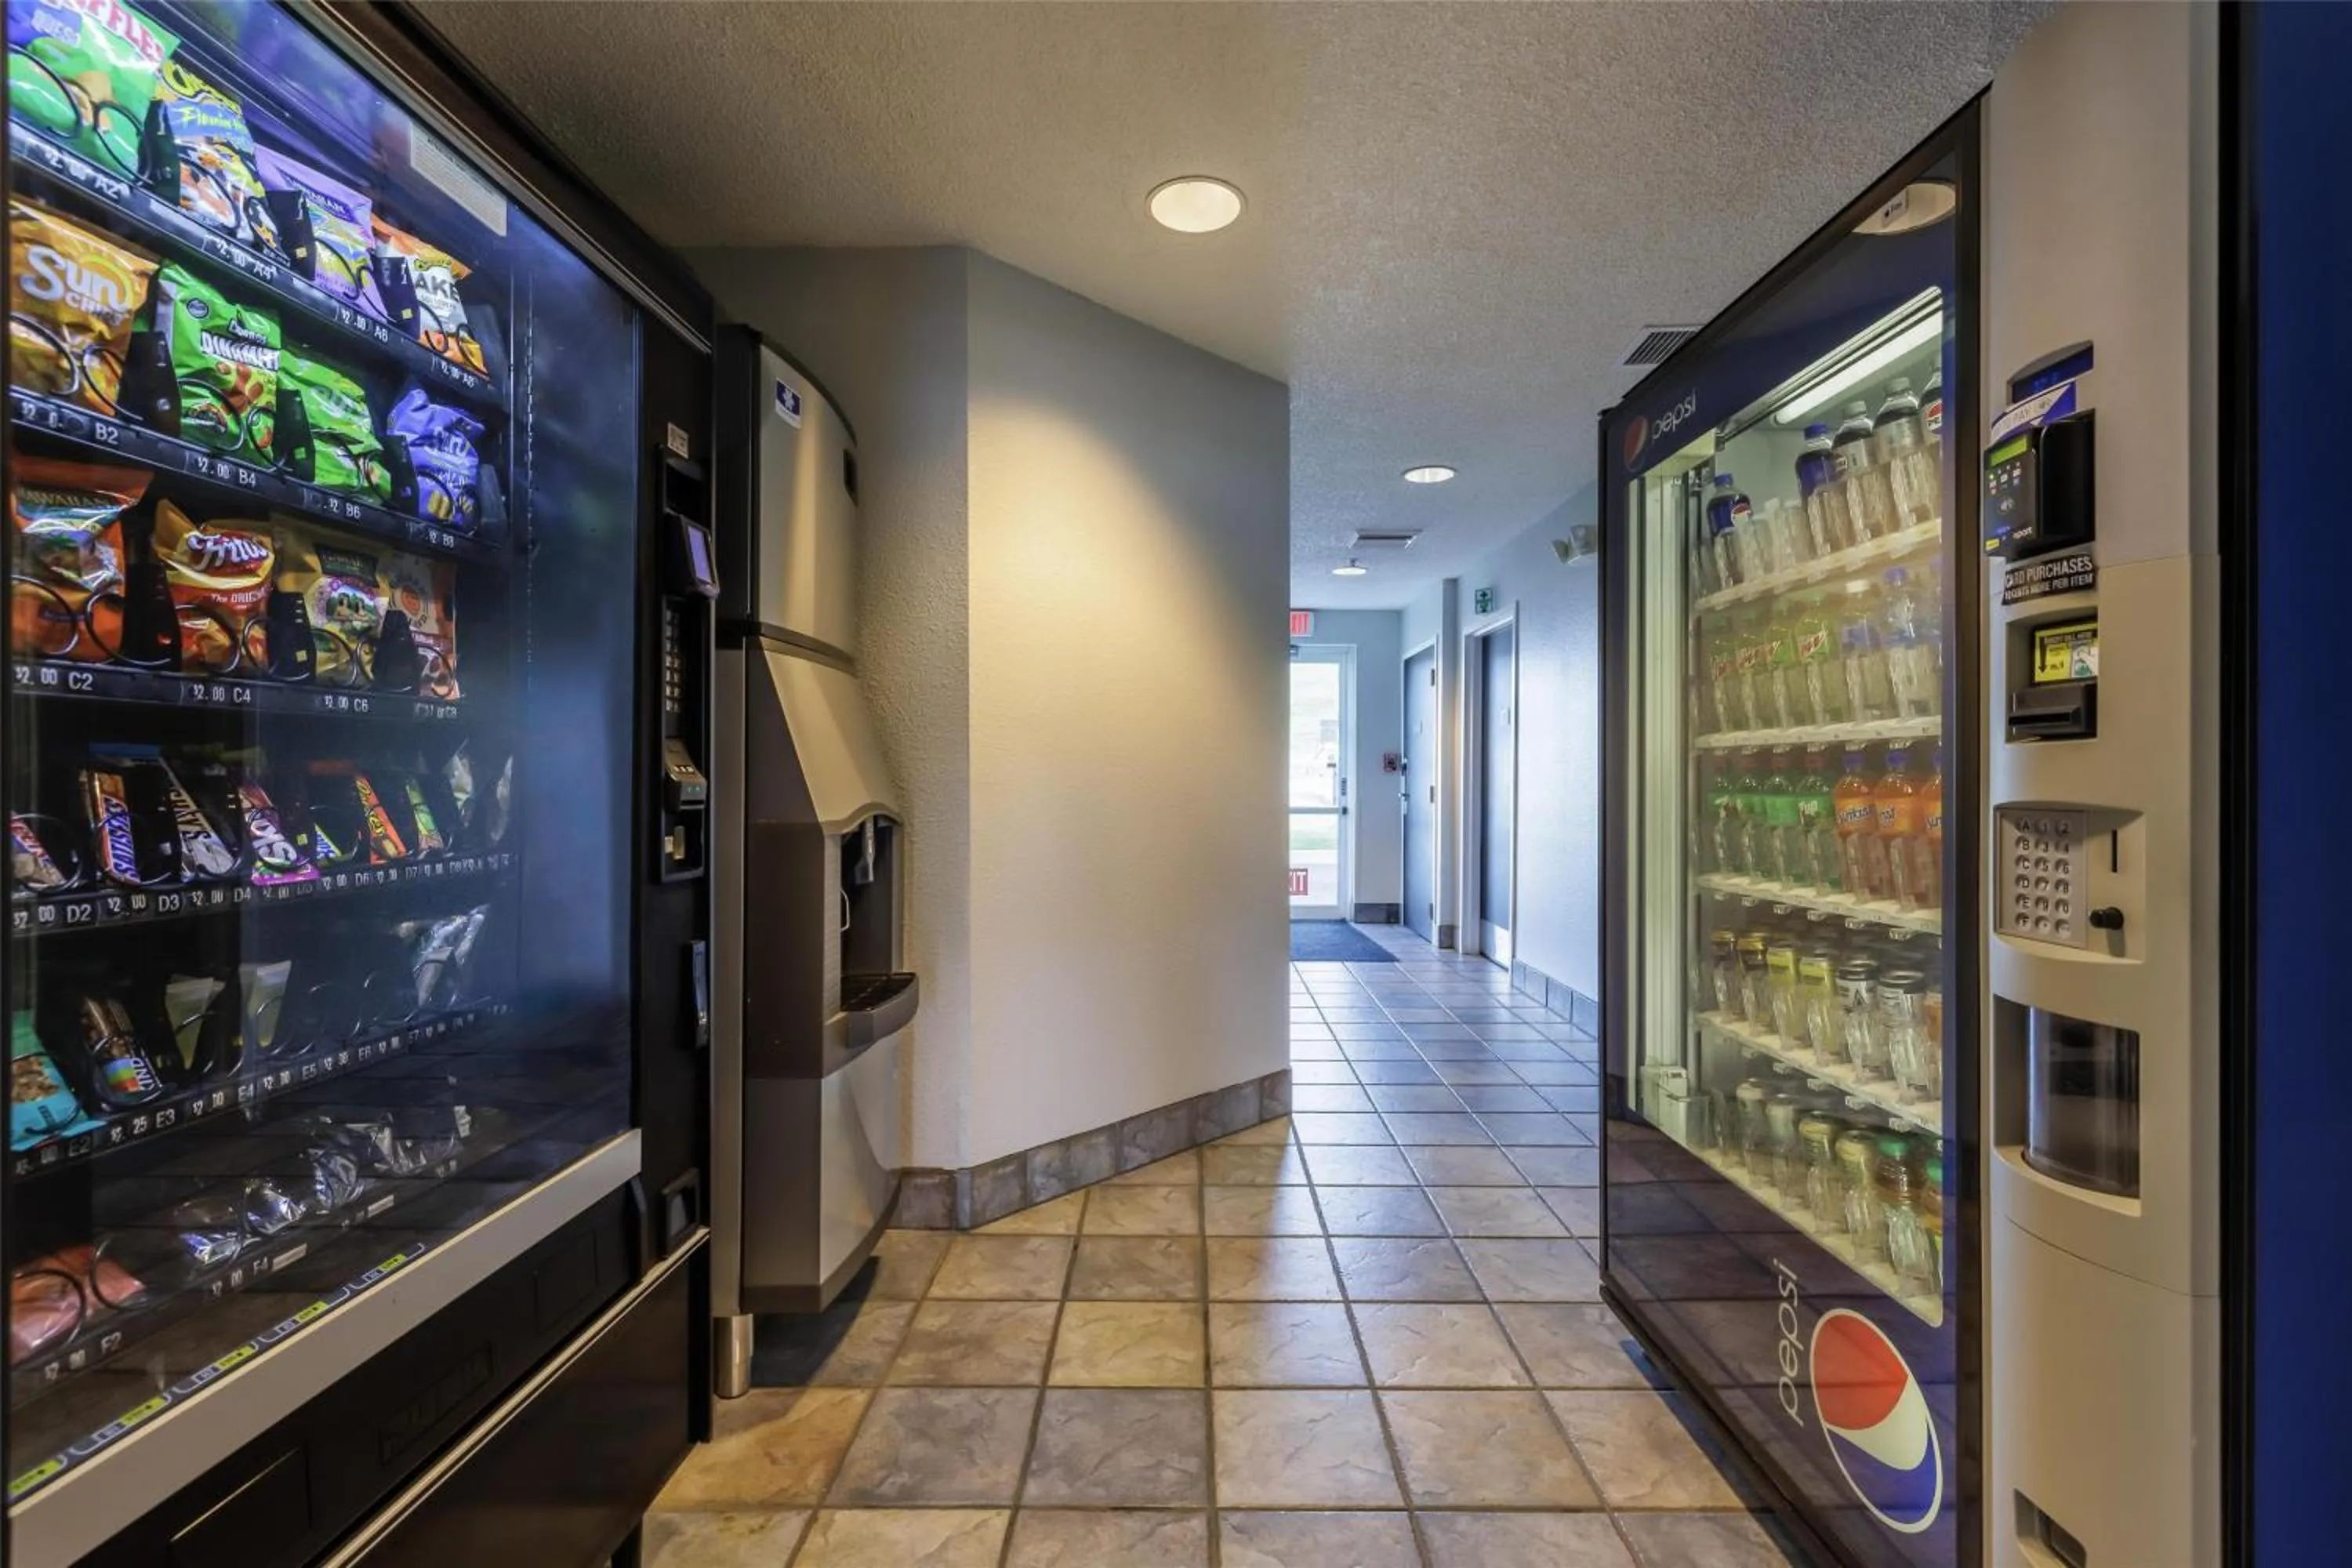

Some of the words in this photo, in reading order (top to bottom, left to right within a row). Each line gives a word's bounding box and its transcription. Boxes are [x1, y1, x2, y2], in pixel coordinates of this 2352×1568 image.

[20, 245, 129, 314] Sun
[1651, 387, 1697, 445] pepsi
[95, 423, 118, 445] B2
[239, 469, 256, 489] B4
[2027, 555, 2093, 582] PURCHASES
[2071, 572, 2093, 587] ITEM
[68, 671, 93, 691] C2
[234, 687, 252, 704] C4
[354, 698, 368, 713] C6
[158, 894, 180, 913] D3
[234, 886, 252, 902] D4
[67, 903, 92, 924] D2
[131, 1055, 156, 1091] KIND
[302, 1063, 318, 1080] E5
[157, 1108, 175, 1127] E3
[1773, 1257, 1804, 1427] pepsi
